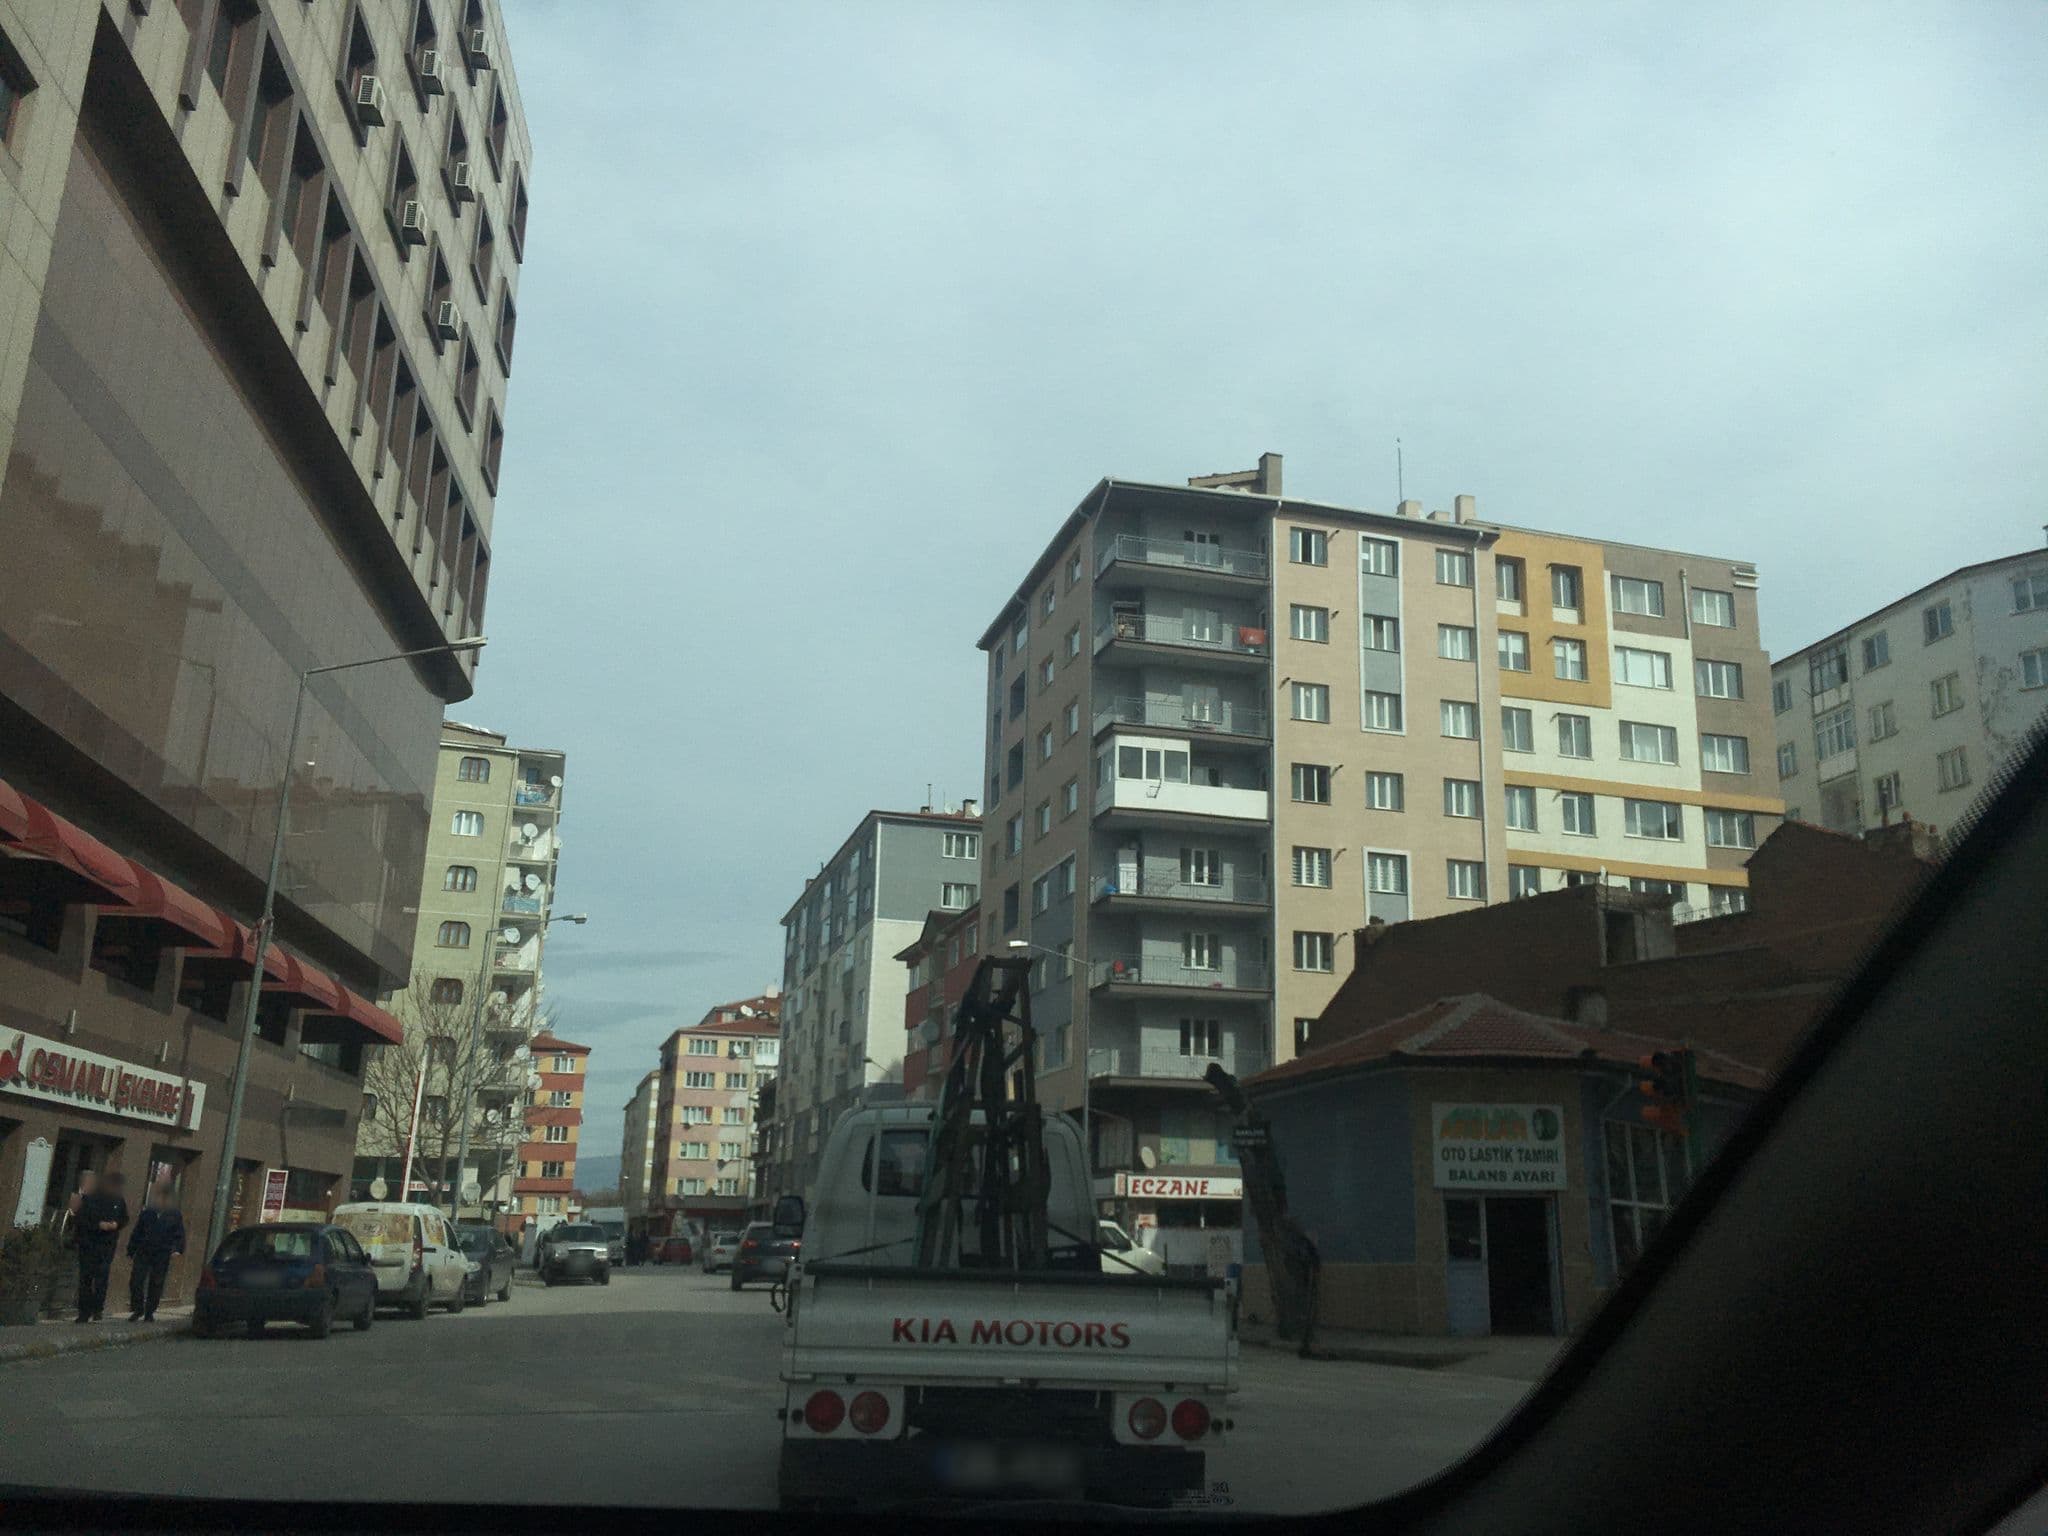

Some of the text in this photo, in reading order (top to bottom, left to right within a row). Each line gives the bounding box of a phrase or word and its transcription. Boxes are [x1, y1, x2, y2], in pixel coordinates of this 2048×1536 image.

[26, 1047, 114, 1102] OSMANLI
[1441, 1146, 1466, 1161] OTO
[1448, 1168, 1507, 1182] BALANS
[1132, 1178, 1209, 1196] ECZANE
[892, 1317, 1131, 1349] KIA MOTORS
